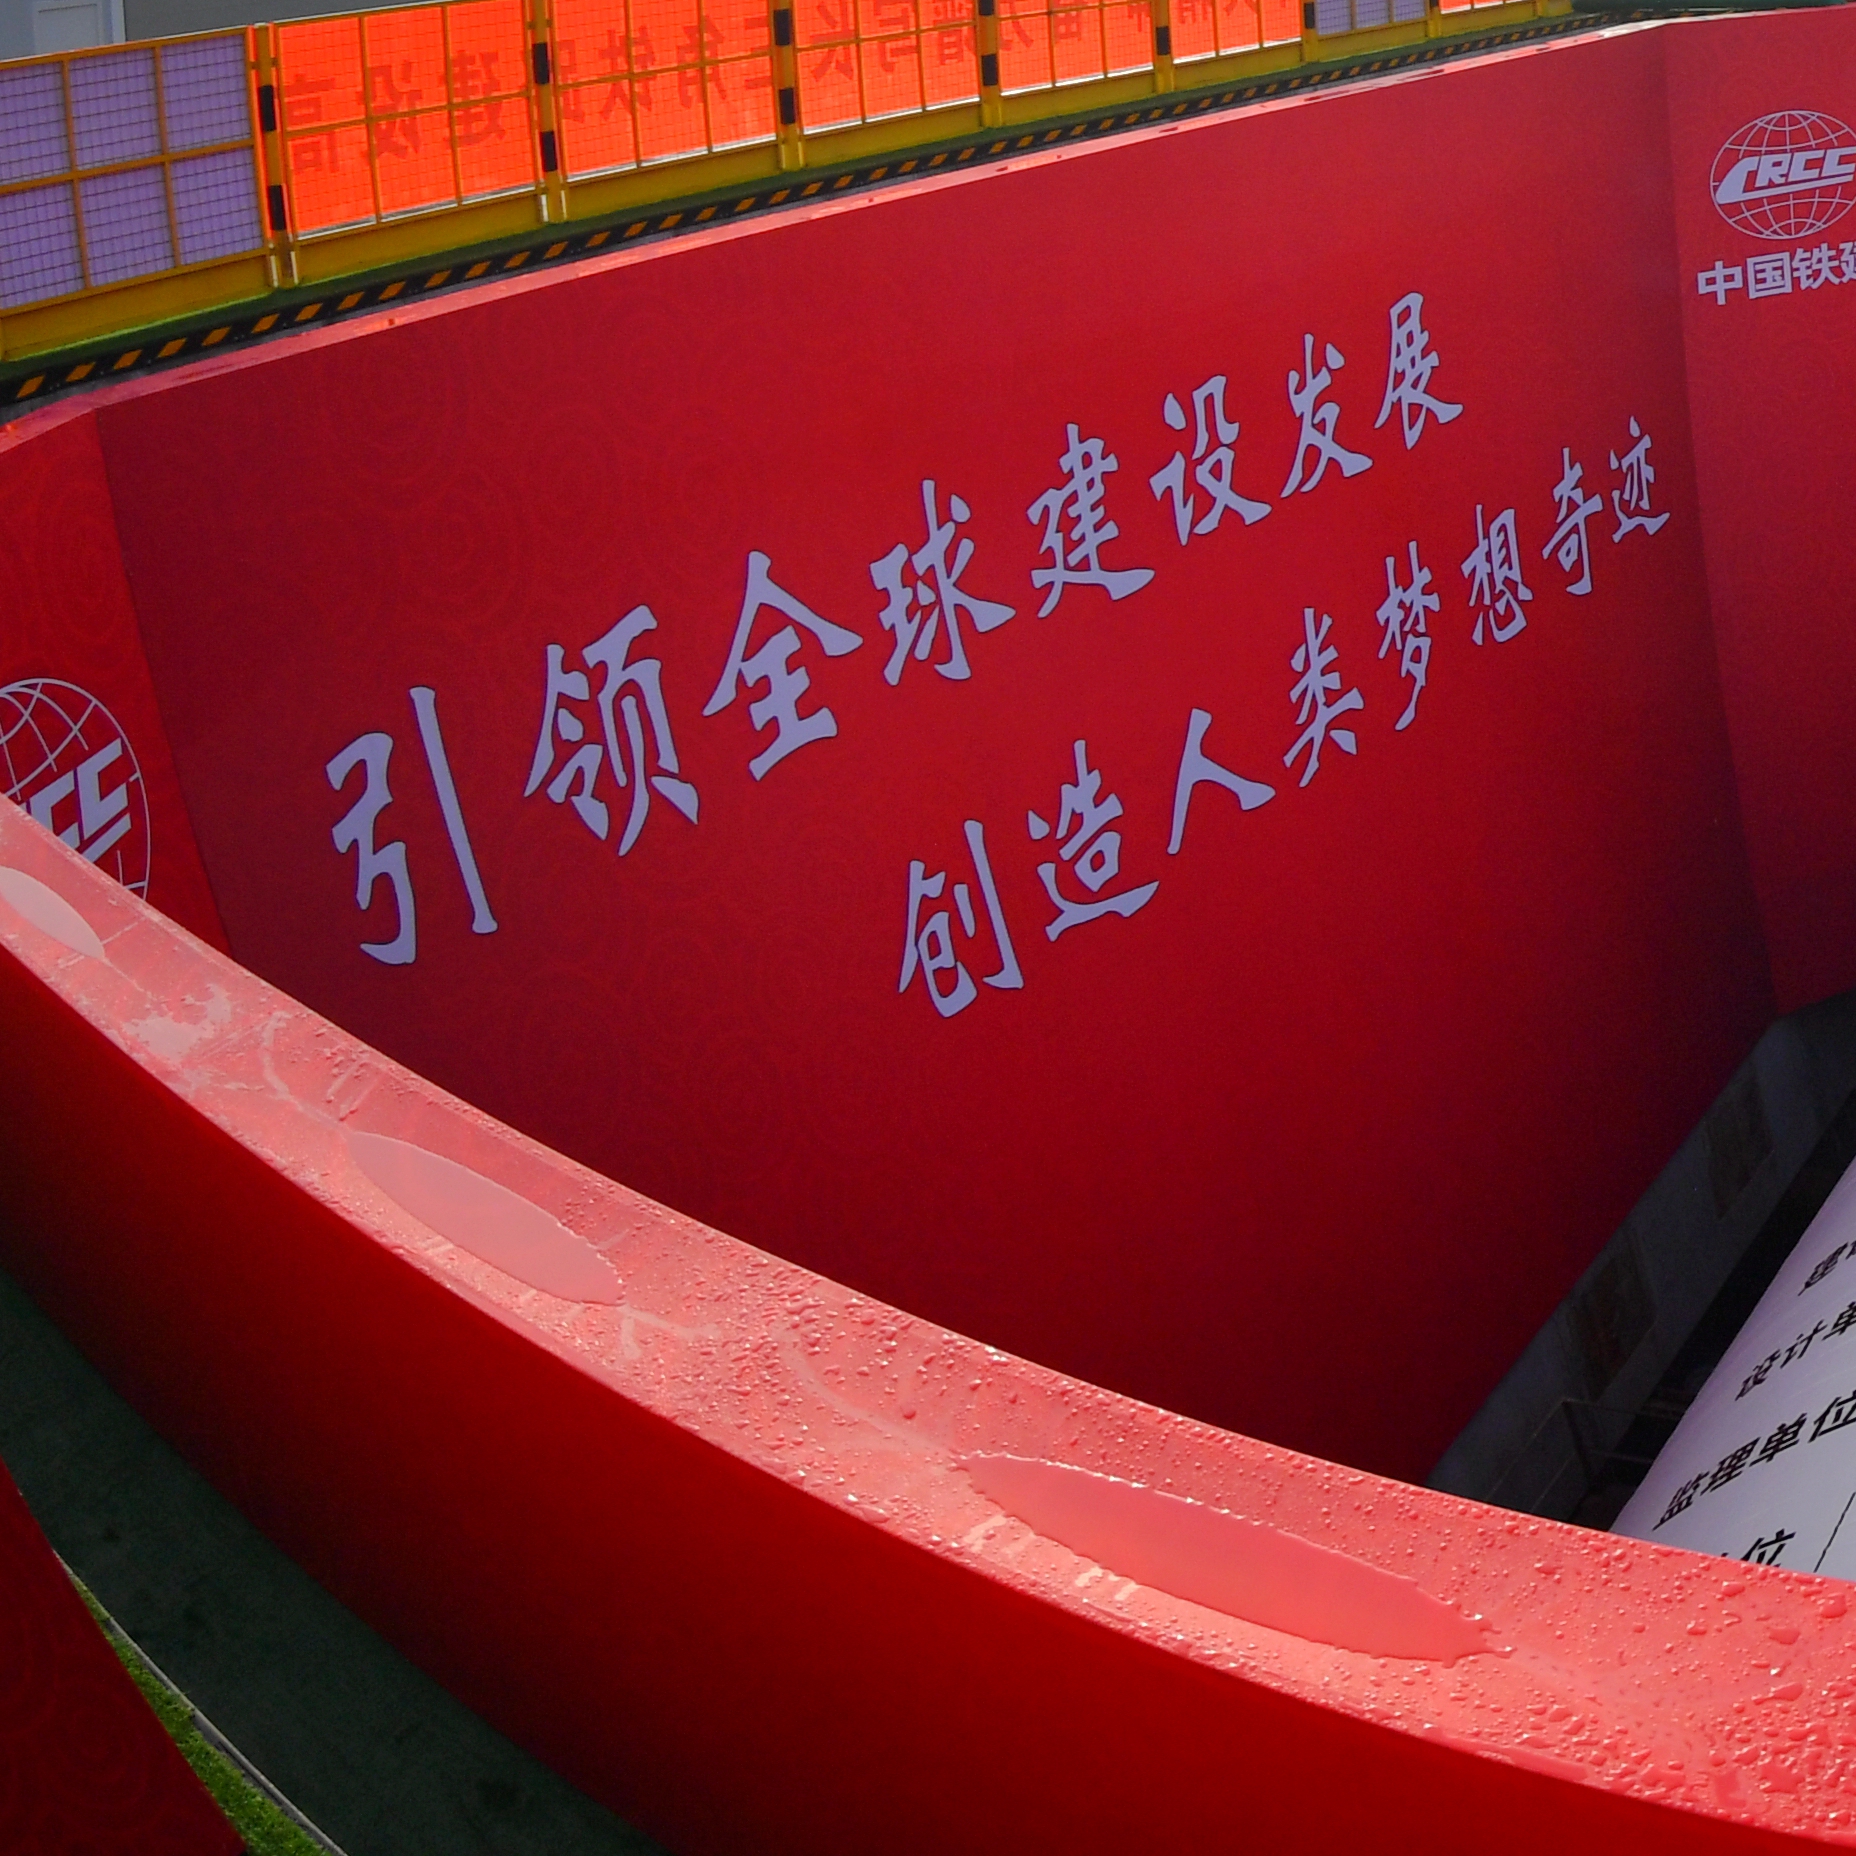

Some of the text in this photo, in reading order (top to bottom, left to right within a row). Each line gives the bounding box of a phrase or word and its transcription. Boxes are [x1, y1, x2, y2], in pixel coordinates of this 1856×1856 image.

[325, 291, 1463, 964] 引领全球建设发展
[897, 416, 1671, 1017] 创造人类梦想奇迹
